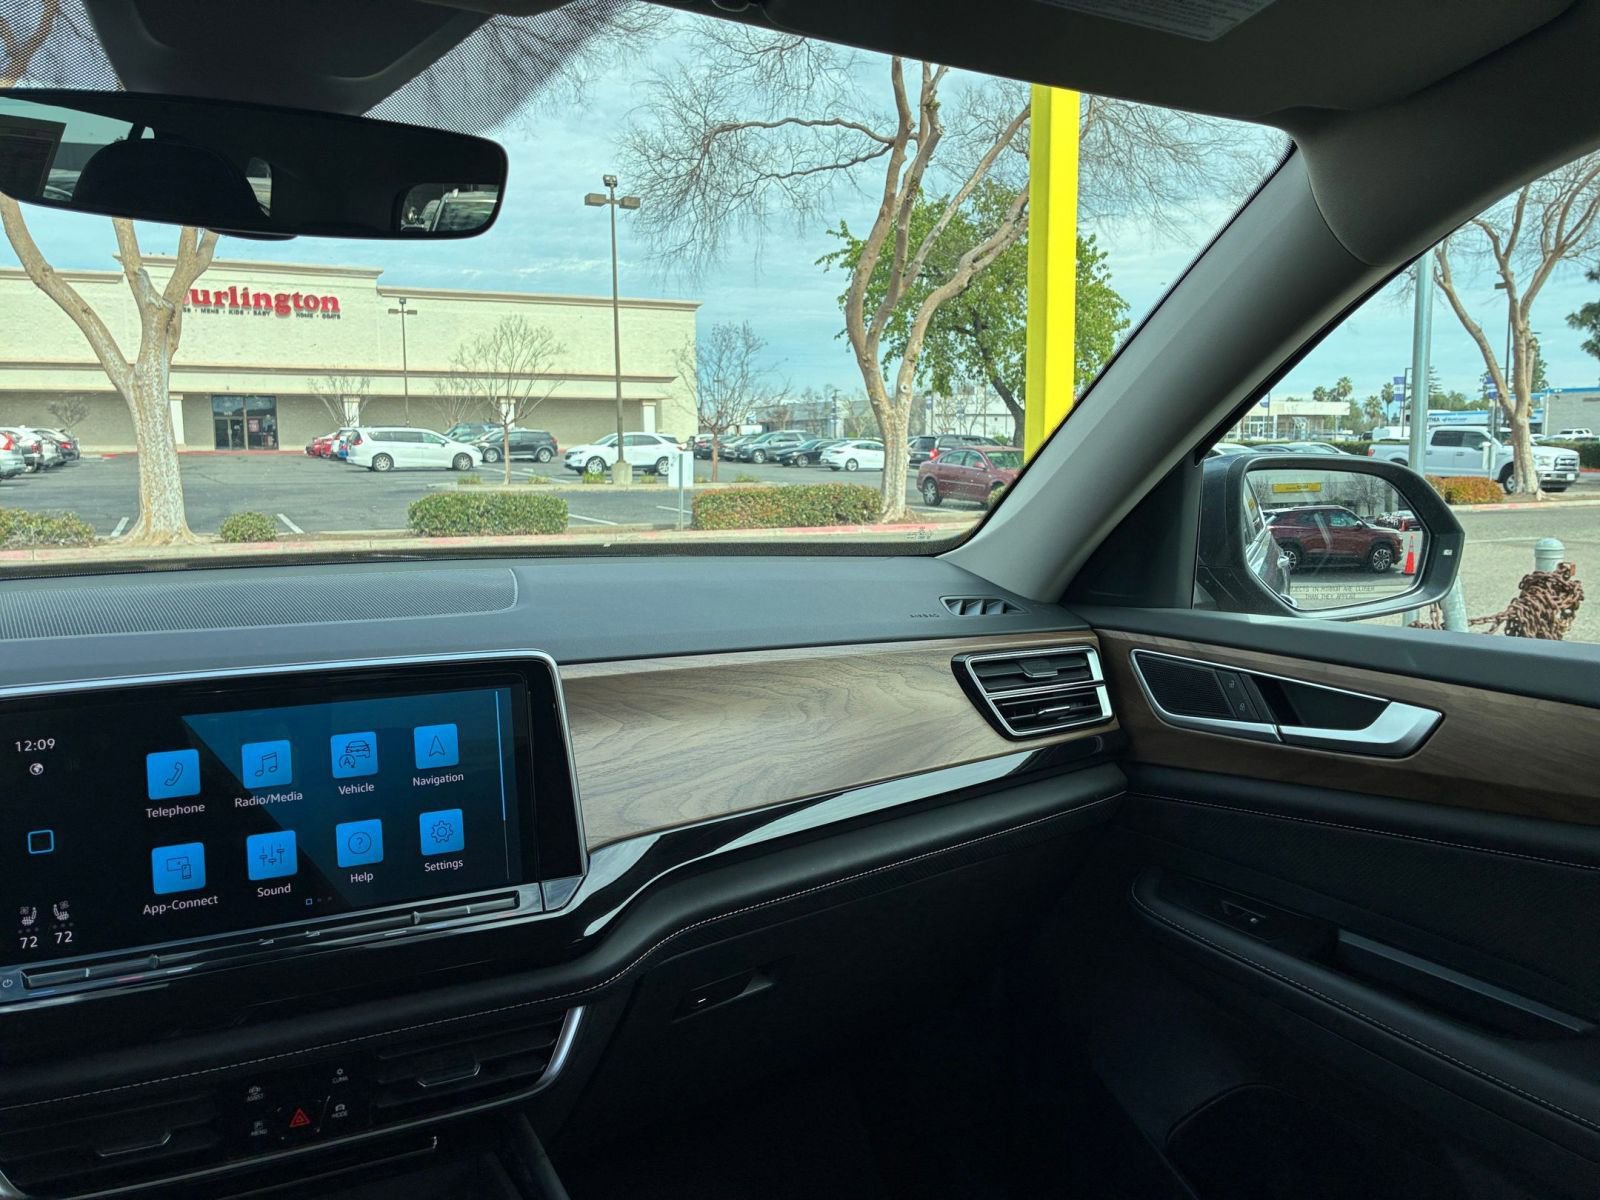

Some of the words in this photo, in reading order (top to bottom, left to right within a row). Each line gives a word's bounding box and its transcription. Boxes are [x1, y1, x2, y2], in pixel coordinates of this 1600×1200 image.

[184, 286, 341, 317] urlington
[15, 738, 56, 753] 12:09
[412, 773, 464, 787] Navigation
[338, 782, 375, 795] Vehicle
[234, 791, 303, 808] Radio/Media
[145, 804, 206, 818] Telephone
[424, 859, 464, 872] Settings
[350, 871, 374, 883] Help
[257, 882, 291, 898] Sound
[143, 895, 219, 916] App-Connect
[19, 935, 38, 949] 72
[54, 930, 73, 944] 72
